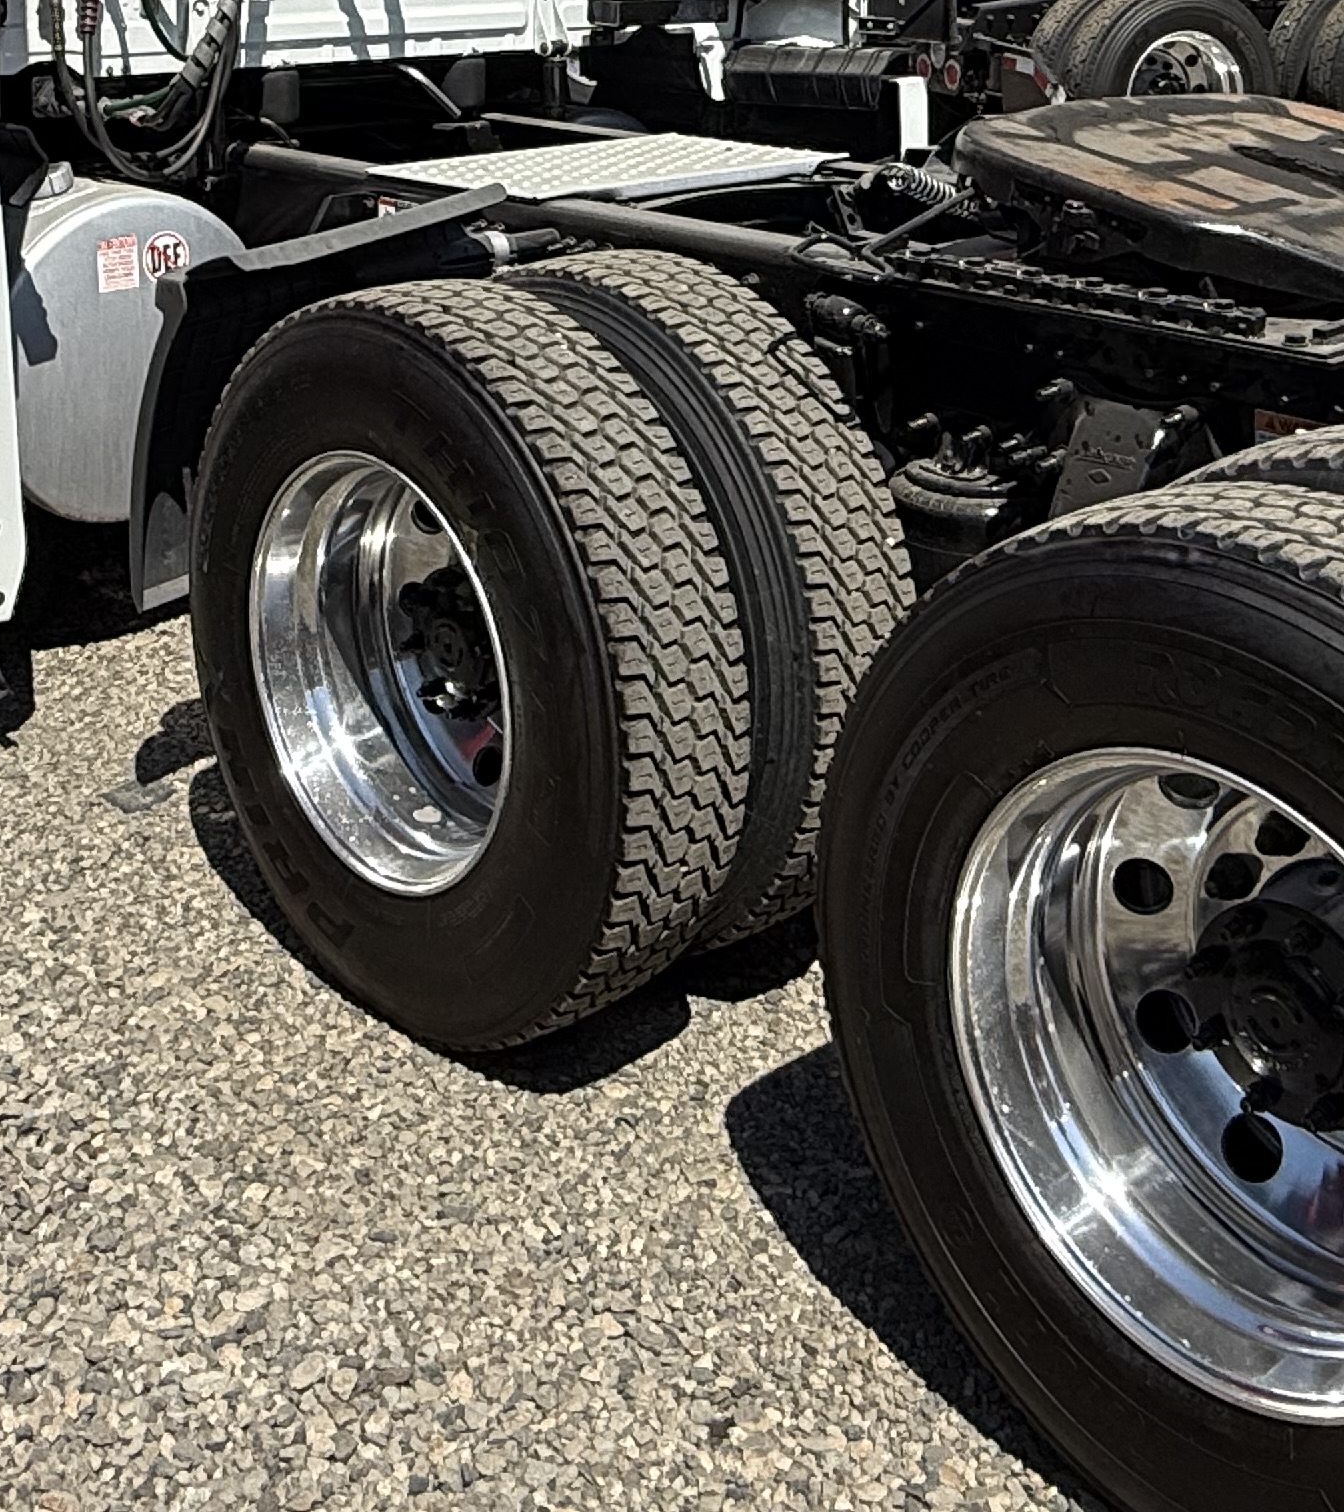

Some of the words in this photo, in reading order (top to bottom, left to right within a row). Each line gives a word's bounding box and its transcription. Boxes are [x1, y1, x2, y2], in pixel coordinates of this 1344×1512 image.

[147, 242, 181, 274] DEF
[900, 693, 963, 771] COOPER
[968, 664, 1014, 699] TIRE
